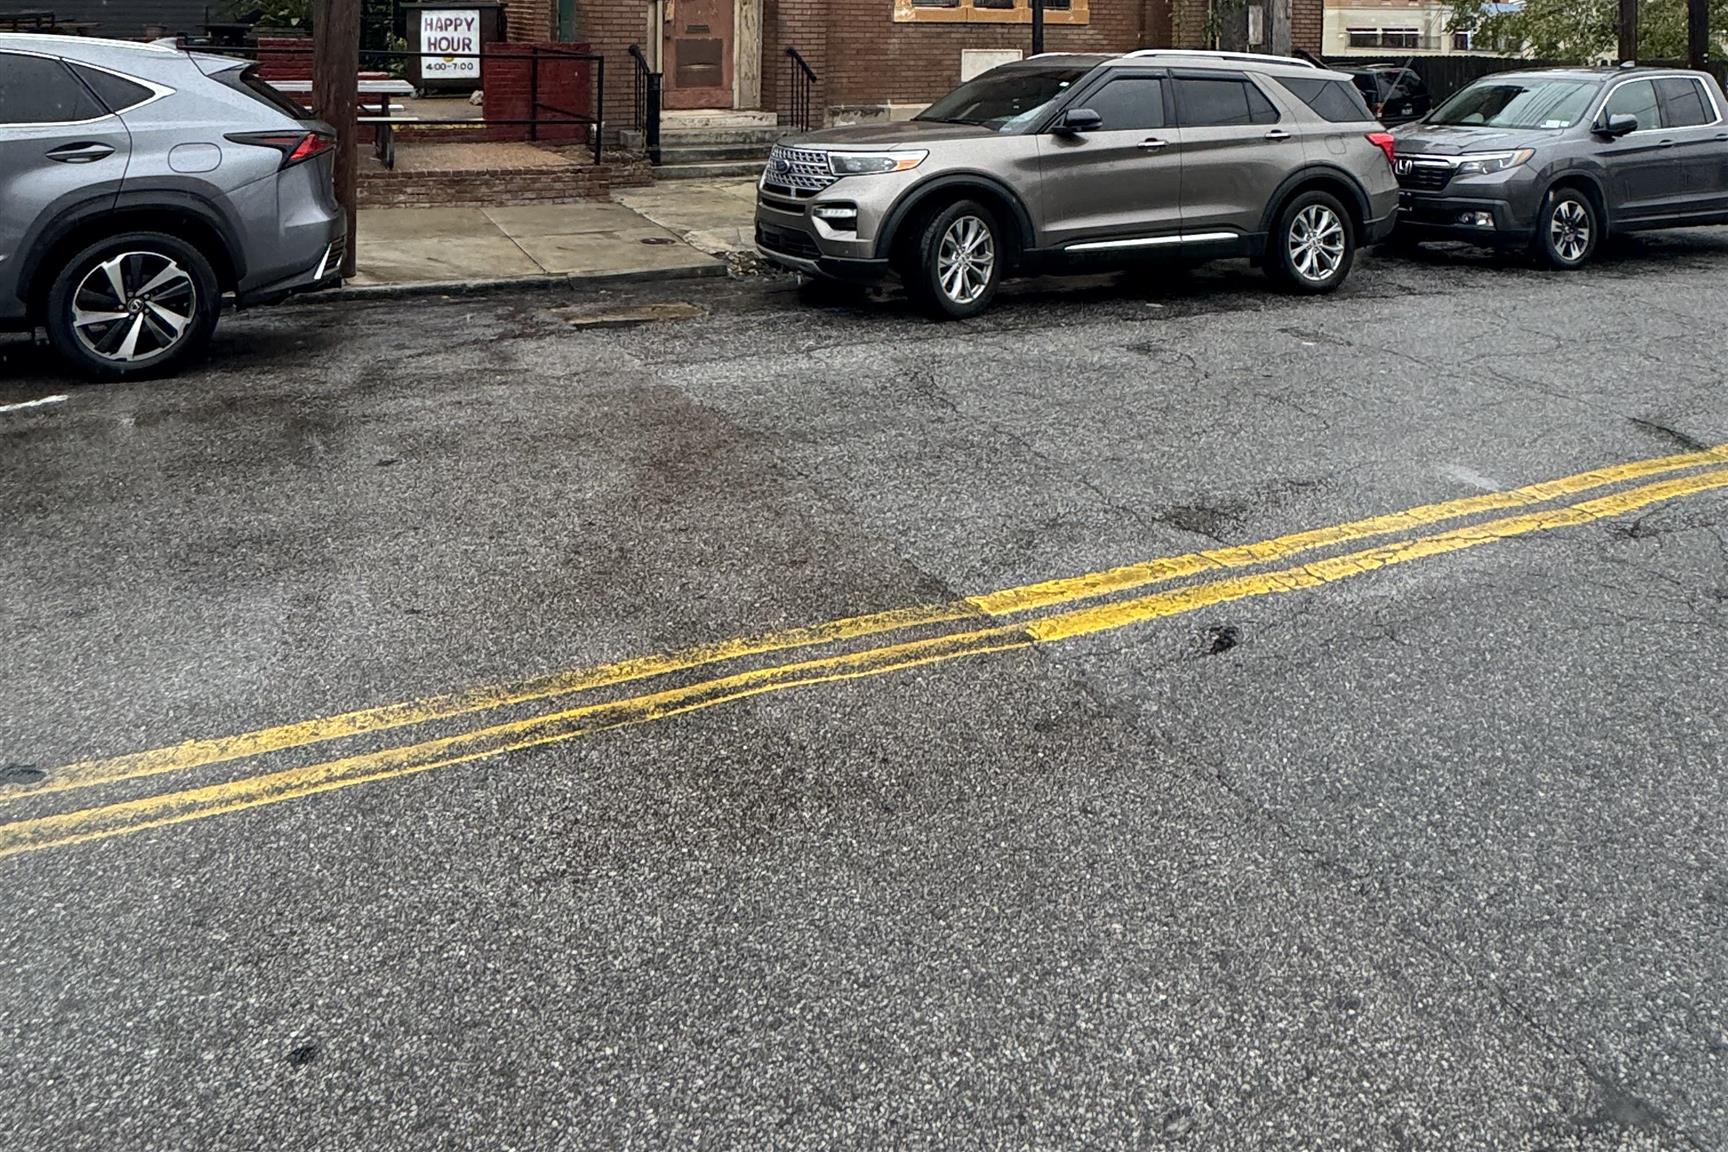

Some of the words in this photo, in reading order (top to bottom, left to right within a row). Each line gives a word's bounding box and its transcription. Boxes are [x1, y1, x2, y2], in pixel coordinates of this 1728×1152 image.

[424, 17, 475, 32] HAPPY
[427, 36, 472, 52] HOUR
[425, 62, 474, 71] 400-7:00
